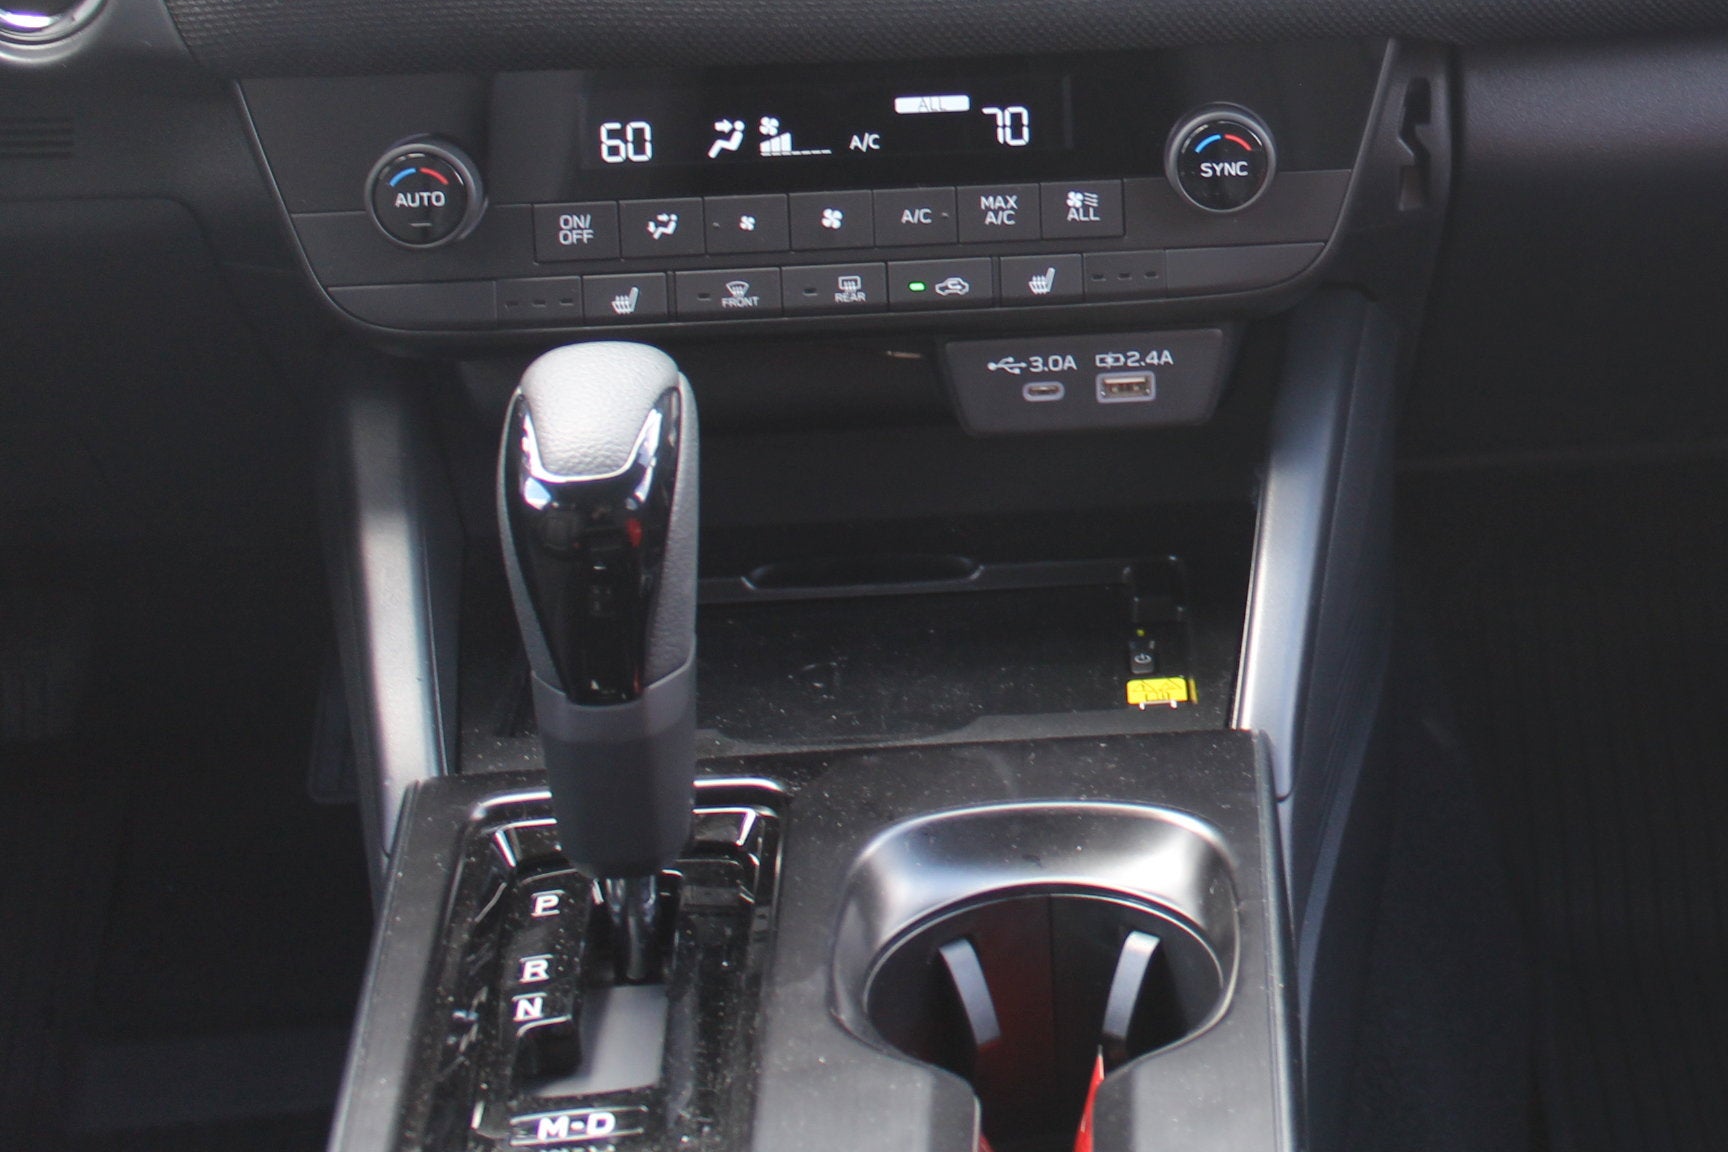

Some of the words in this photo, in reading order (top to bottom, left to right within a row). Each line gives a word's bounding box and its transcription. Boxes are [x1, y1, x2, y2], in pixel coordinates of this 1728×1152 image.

[982, 106, 1029, 146] 70
[600, 121, 652, 162] 60
[850, 133, 879, 151] A/C
[1201, 161, 1248, 177] SYNC
[394, 191, 445, 208] AUTO
[981, 196, 1017, 209] MAX
[902, 209, 931, 223] A/C
[985, 210, 1015, 225] A/C
[1067, 209, 1099, 221] ALL
[559, 230, 593, 244] OFF
[722, 297, 759, 308] FRONT
[835, 292, 866, 302] REAR
[1030, 355, 1077, 372] 3.0A
[1127, 350, 1173, 366] 2.4A
[535, 896, 560, 914] P
[523, 961, 549, 980] R
[515, 997, 543, 1019] N
